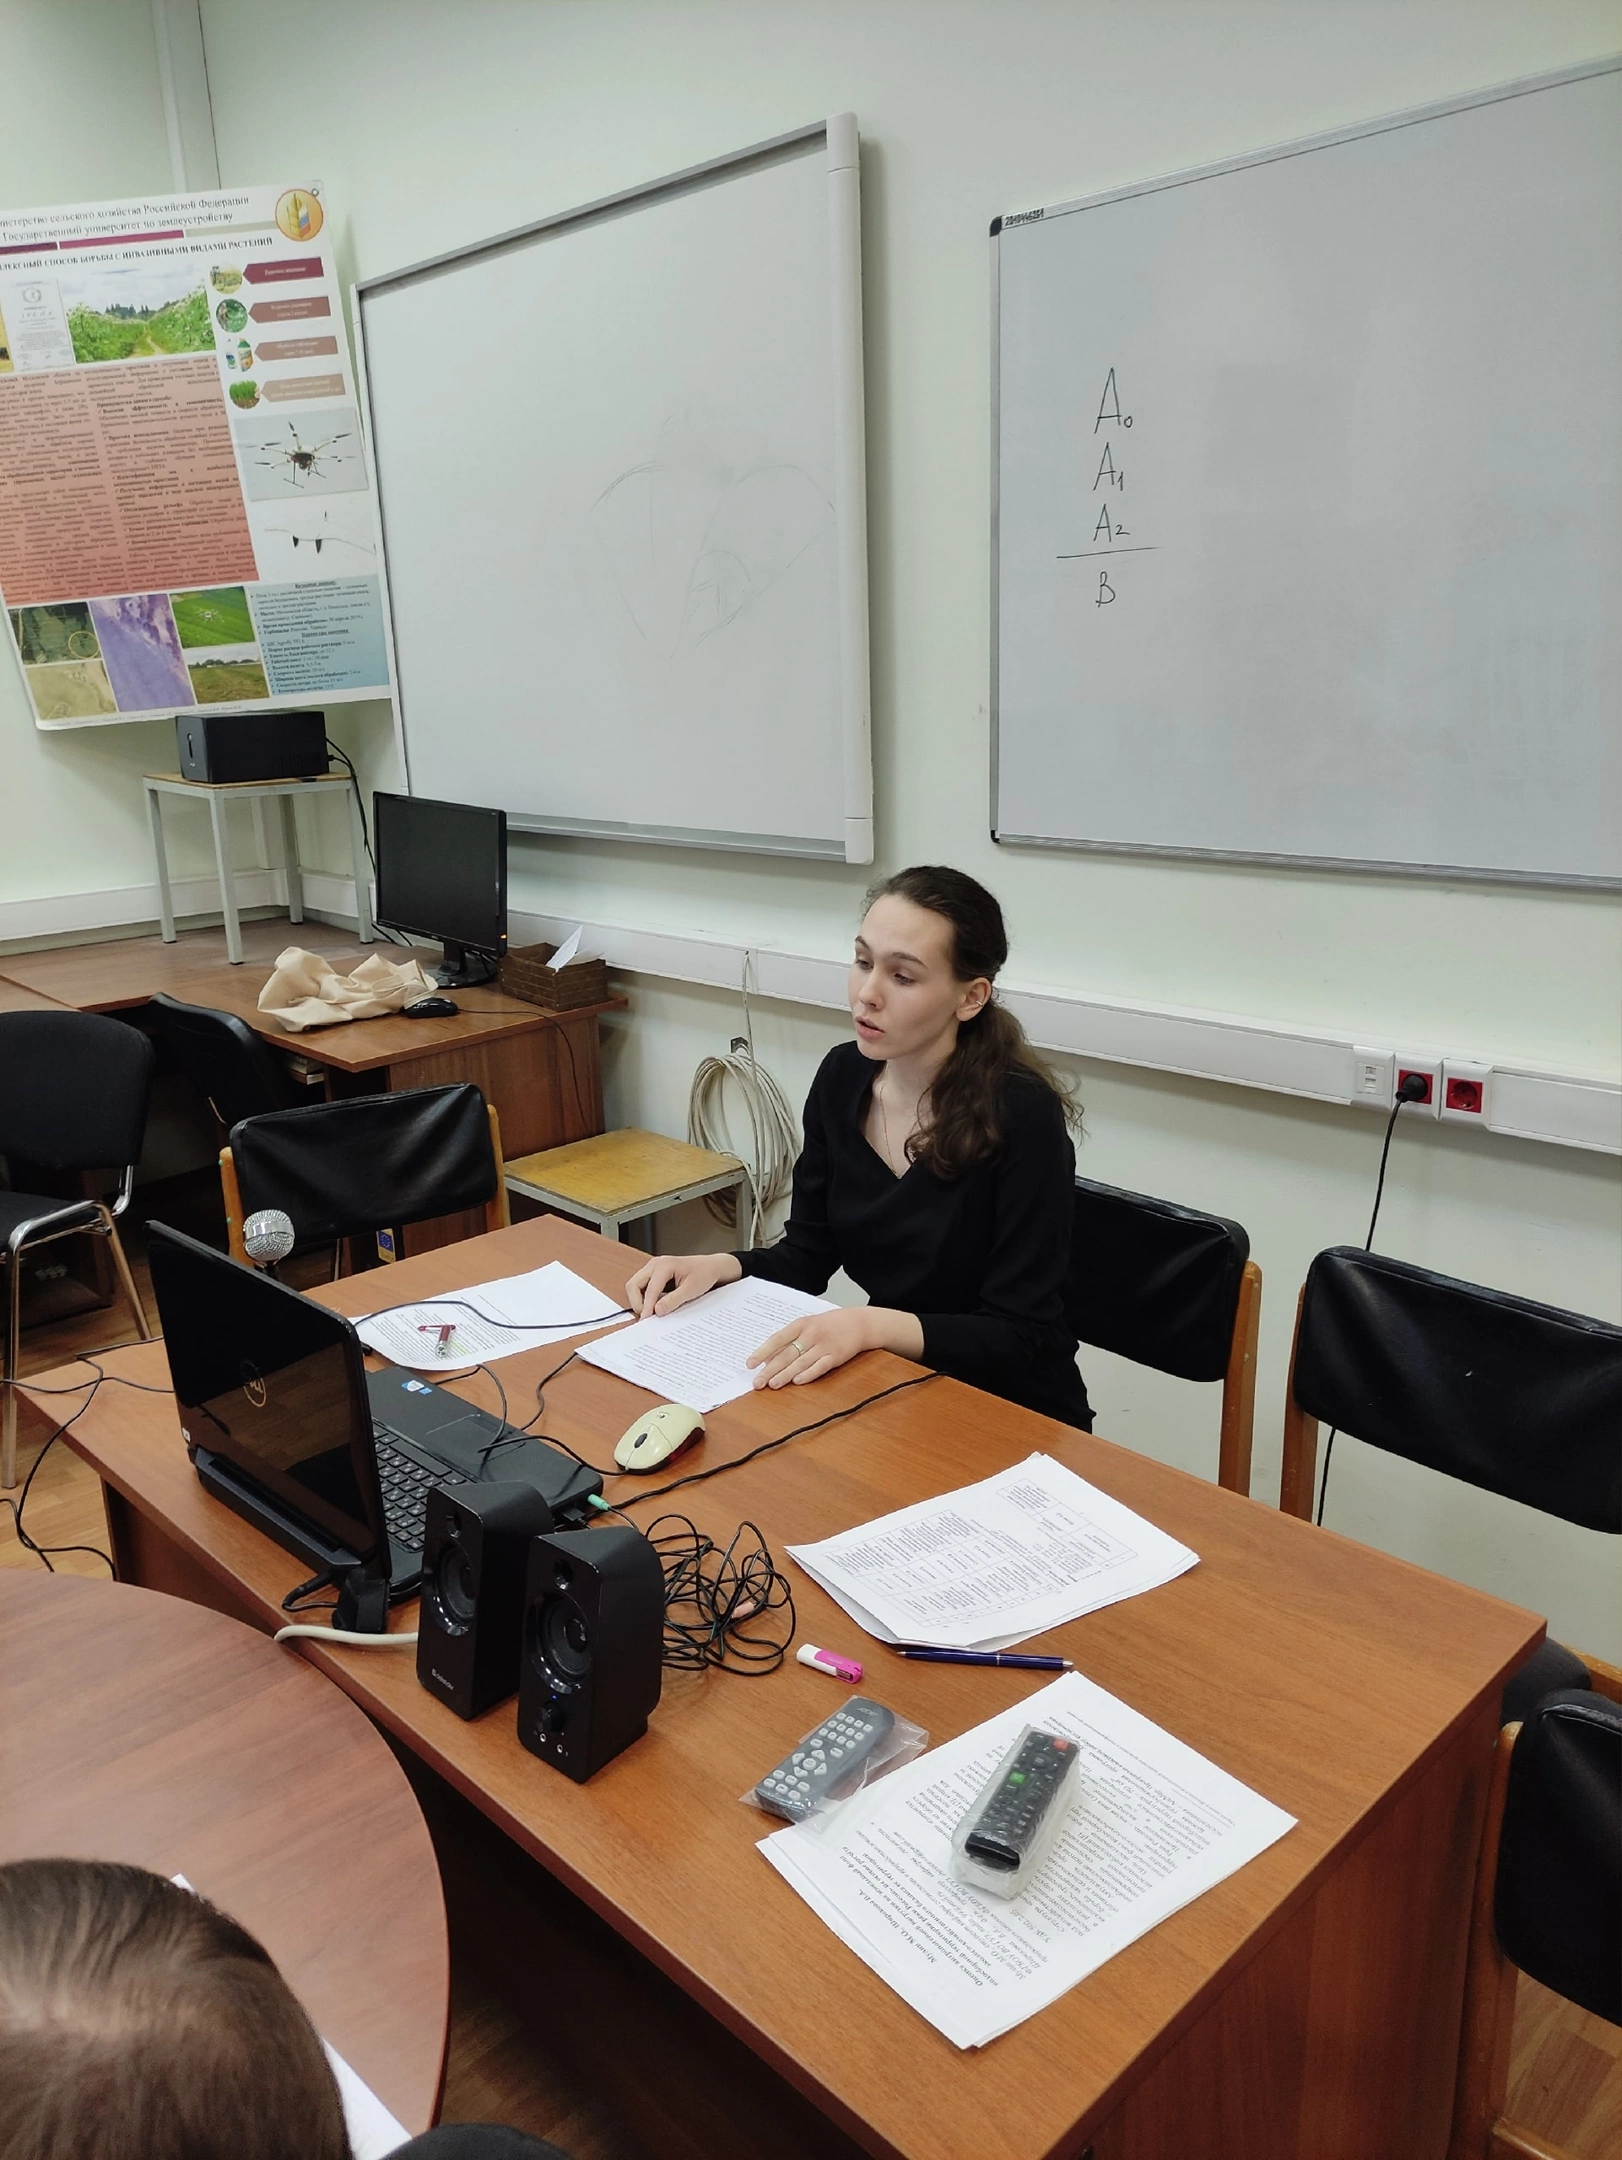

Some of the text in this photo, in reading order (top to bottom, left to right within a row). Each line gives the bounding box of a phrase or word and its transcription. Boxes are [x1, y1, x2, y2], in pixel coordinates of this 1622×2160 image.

[142, 201, 197, 216] Российской
[198, 196, 250, 210] Федерации
[2, 226, 82, 243] Государственный
[158, 211, 234, 229] землеустройству
[228, 236, 273, 250] РАСТЕНИЙ
